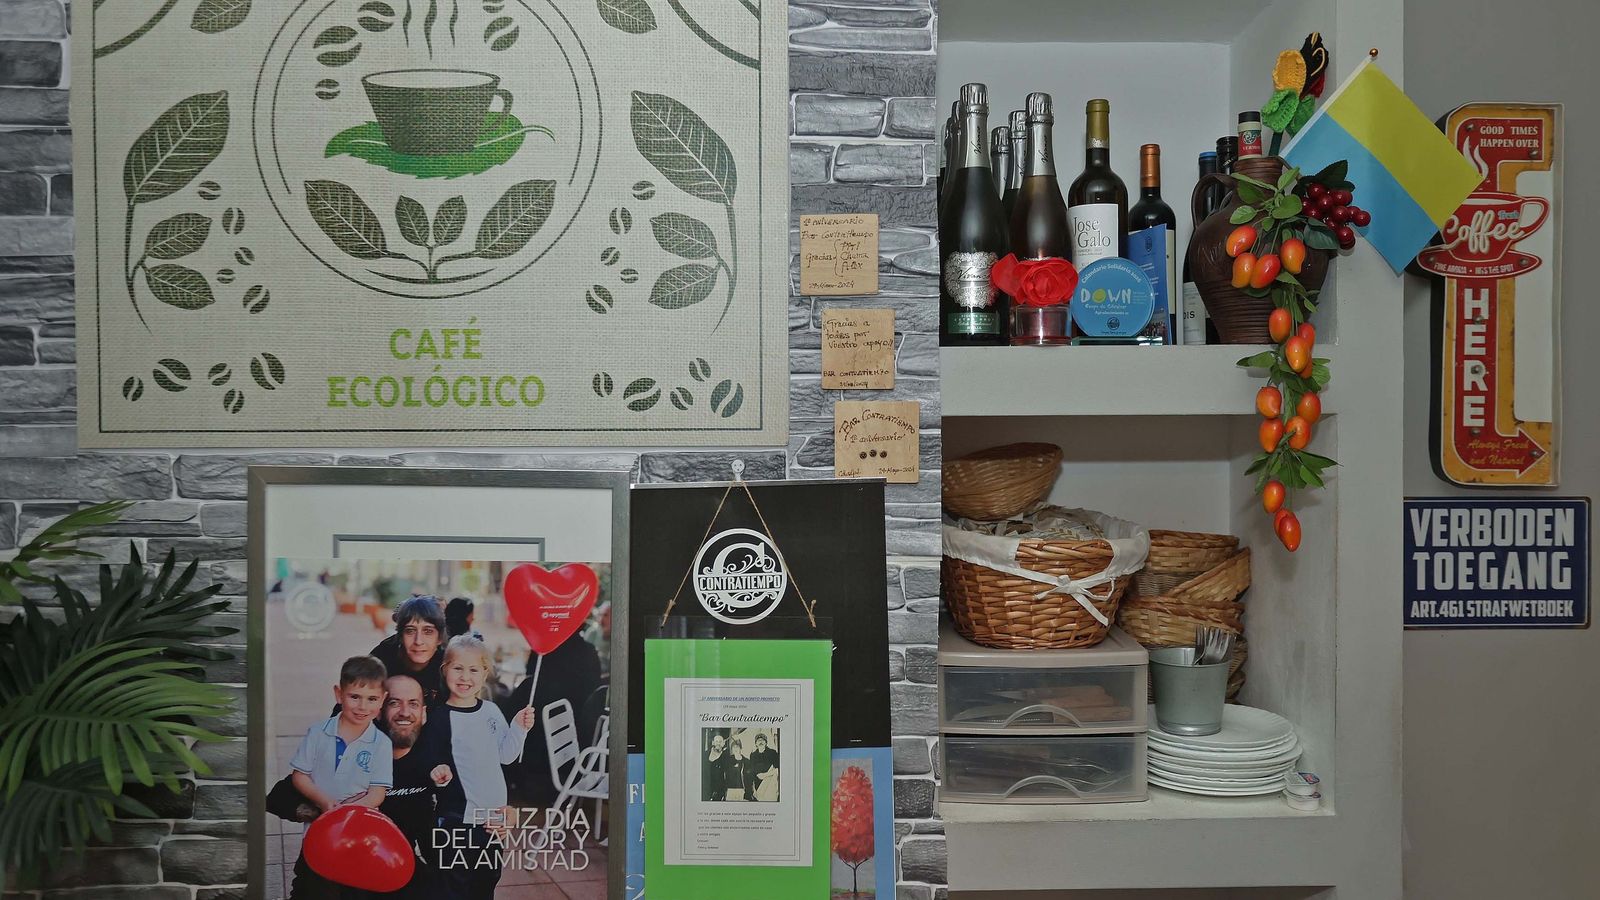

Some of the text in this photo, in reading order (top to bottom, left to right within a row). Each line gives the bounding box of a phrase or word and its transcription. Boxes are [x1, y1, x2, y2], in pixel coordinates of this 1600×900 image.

[1480, 126, 1539, 135] GOOD TIMES
[1480, 139, 1539, 148] HAPPEN OVER
[1077, 230, 1111, 248] Galo
[1442, 210, 1526, 254] Coffee
[1080, 288, 1132, 304] DOWN
[389, 316, 482, 360] CAFÉ
[1462, 289, 1489, 427] HERE
[327, 363, 545, 408] ECOLÓGICO
[1409, 508, 1575, 547] VERBODEN
[1412, 551, 1572, 591] TOEGANG
[699, 575, 782, 591] CONTRATIEMPO
[1466, 600, 1574, 618] STRAFWETBOEK
[473, 804, 590, 830] FELIZ DÍA
[432, 828, 590, 850] DEL AMOR Y
[439, 849, 589, 871] LA AMISTAD
